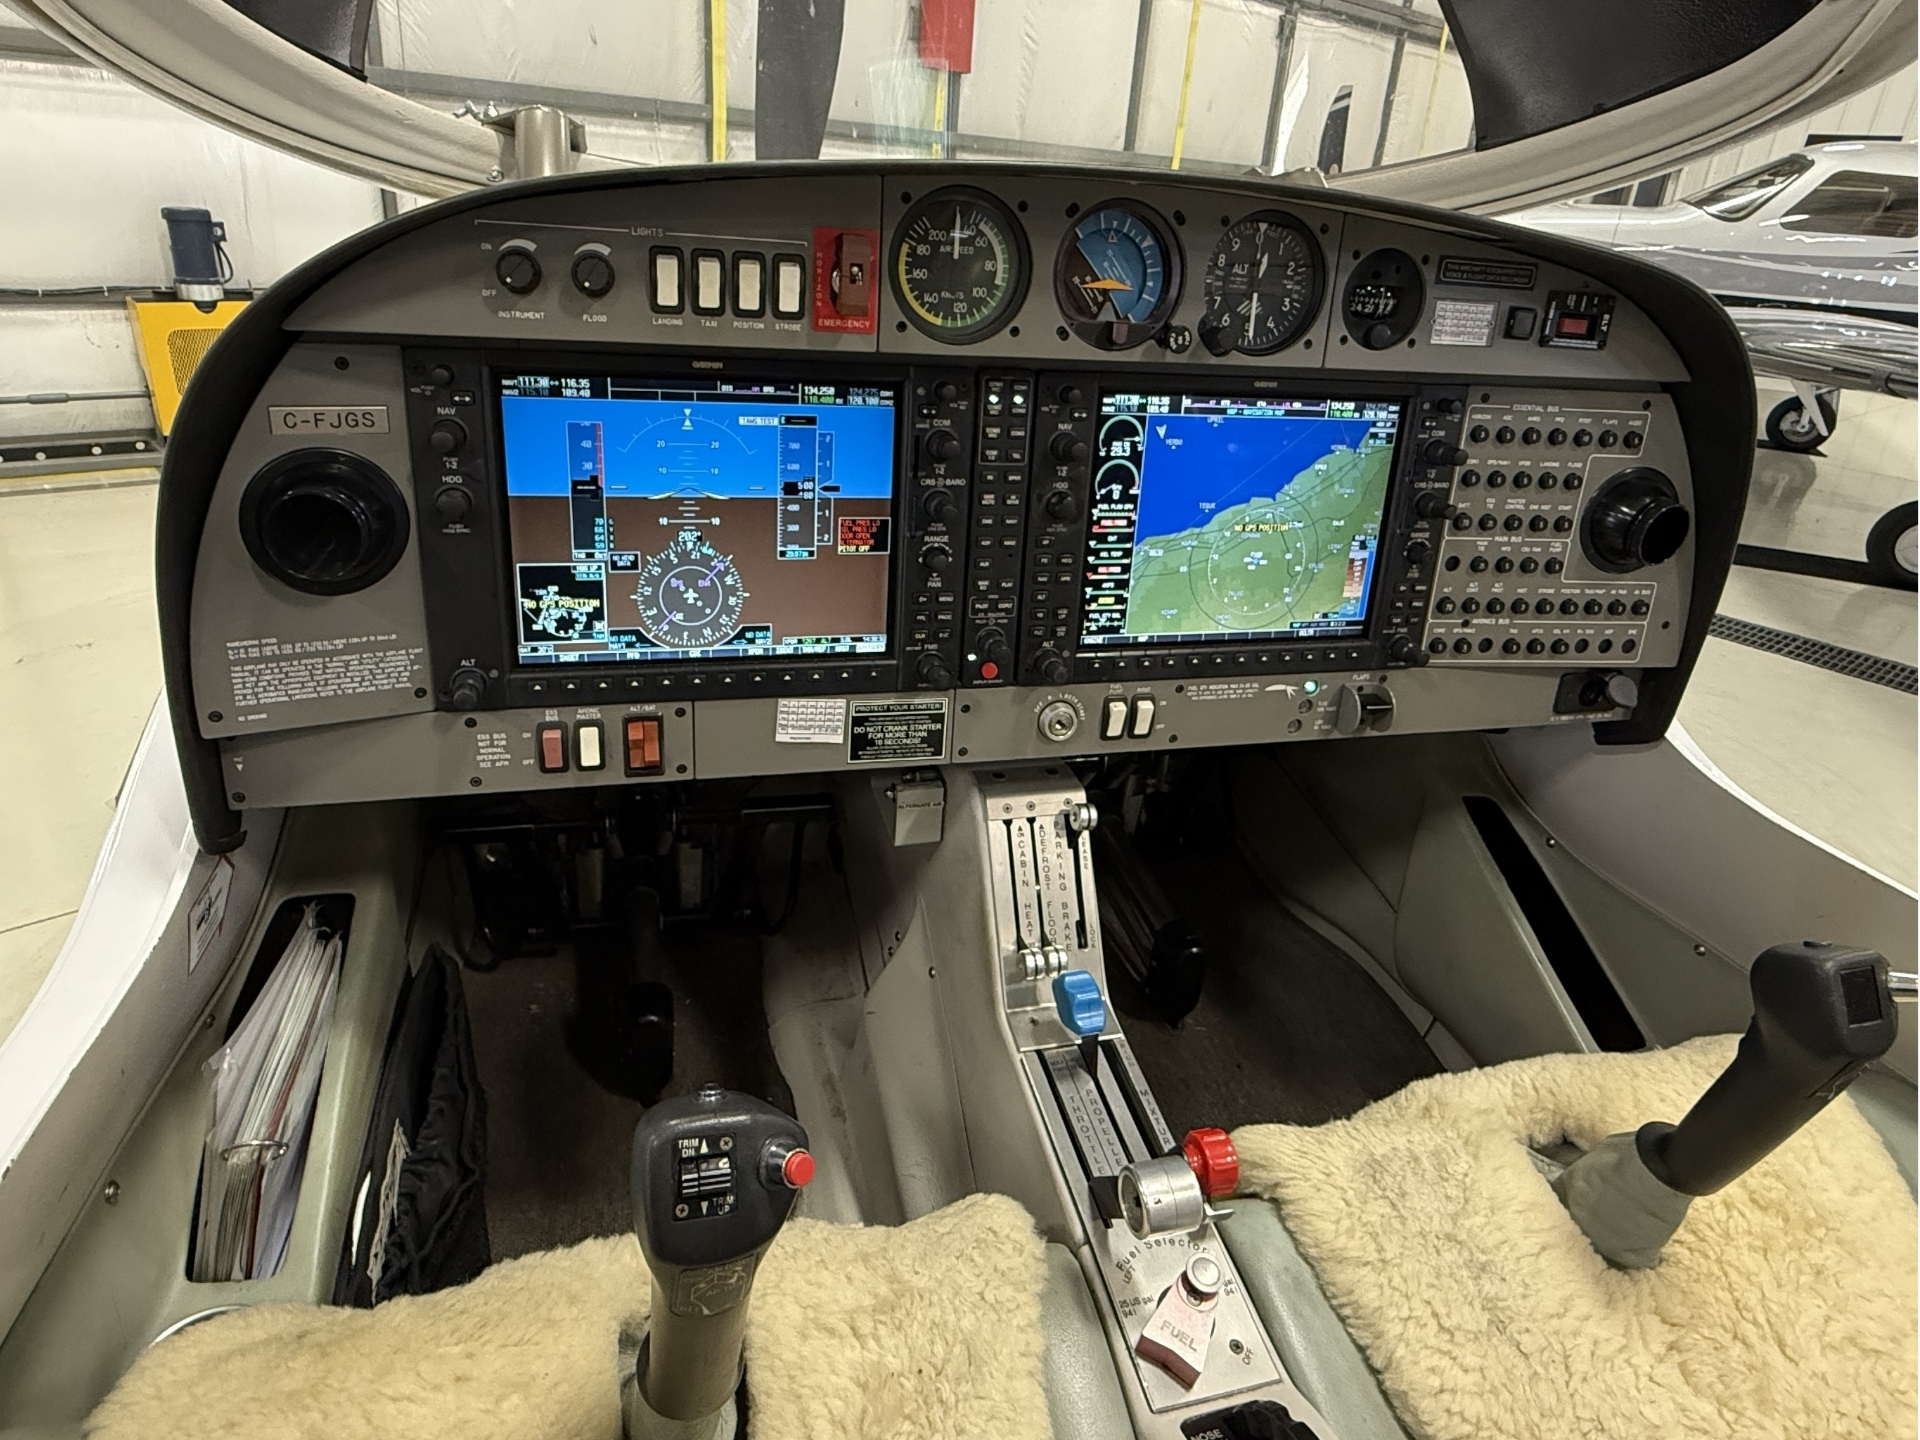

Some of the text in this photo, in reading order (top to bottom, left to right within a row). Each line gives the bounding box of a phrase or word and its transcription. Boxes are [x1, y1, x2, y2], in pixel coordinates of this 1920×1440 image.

[631, 227, 664, 237] LIGHTS
[928, 229, 947, 241] 200
[964, 225, 976, 236] 40
[975, 237, 988, 248] 60
[1256, 232, 1264, 245] 0
[916, 244, 930, 255] 180
[1231, 238, 1241, 251] 9
[1279, 243, 1285, 255] 1
[939, 246, 974, 255] AIREED
[1217, 254, 1226, 266] 8
[984, 260, 996, 271] 80
[1232, 264, 1250, 275] ALT
[1286, 262, 1295, 275] 2
[912, 268, 928, 279] 160
[481, 289, 497, 297] OFF
[972, 287, 987, 298] 100
[924, 294, 939, 304] 140
[1213, 297, 1222, 309] 7
[953, 302, 967, 313] 120
[1281, 298, 1291, 311] 3
[1351, 302, 1364, 311] 24
[498, 311, 545, 320] INSTRUMENT
[582, 314, 607, 323] FLOOD
[1222, 313, 1230, 326] 6
[652, 318, 683, 326] LANDING
[818, 319, 871, 330] EMERGENCY
[1266, 316, 1277, 327] 4
[1601, 313, 1610, 332] ELT
[775, 323, 802, 331] STROBE
[1244, 323, 1252, 335] 5
[518, 377, 549, 387] 111.30
[560, 379, 590, 388] 116.35
[804, 386, 835, 396] 134.250
[437, 406, 456, 415] NAV
[1513, 404, 1544, 412] ESSENTIAL
[283, 412, 376, 429] C-FJGS
[743, 416, 776, 425] TAWS TEST
[933, 420, 951, 428] COM
[1058, 423, 1073, 432] NAV
[656, 439, 666, 448] 20
[825, 434, 831, 444] 2
[580, 440, 592, 449] 40
[710, 440, 720, 449] 20
[788, 441, 800, 450] 700
[1110, 446, 1130, 456] 29.3
[581, 462, 593, 471] 30
[787, 464, 800, 472] 600
[826, 460, 831, 468] 1
[658, 466, 667, 475] 10
[711, 467, 720, 475] 10
[442, 474, 463, 484] HDG
[920, 479, 936, 487] CRS
[1053, 482, 1069, 491] HDG
[788, 503, 800, 512] 400
[658, 517, 668, 526] 10
[711, 516, 721, 525] 10
[786, 524, 800, 533] 300
[823, 533, 830, 543] 2
[924, 535, 949, 543] RANGE
[927, 581, 942, 589] PAN
[525, 599, 600, 609] NO GPS POSITION
[1472, 617, 1496, 625] AVIONICS
[924, 643, 938, 652] FMS
[1042, 640, 1055, 648] ALT
[461, 656, 476, 665] ALT
[910, 723, 942, 731] STARTER
[1081, 834, 1090, 870] LEASE
[1039, 830, 1051, 891] DEFROST
[1018, 840, 1034, 938] CABIN HEAT
[1054, 821, 1073, 952] PARKING BRAKE
[1047, 901, 1057, 945] FLOOR
[1089, 923, 1097, 949] LOCK
[1139, 1088, 1173, 1147] MIXTUR
[1085, 1088, 1123, 1168] PROPELLE
[1068, 1095, 1107, 1175] THROTTLE
[678, 1138, 699, 1148] TRIM
[681, 1148, 695, 1159] DN
[713, 1195, 735, 1206] TRIM
[717, 1205, 730, 1216] UP
[1115, 1236, 1208, 1273] Fuel Selector
[1122, 1265, 1136, 1284] LEFT
[1118, 1298, 1130, 1309] 25
[1130, 1295, 1142, 1307] US
[1160, 1319, 1198, 1352] FUEL
[1241, 1346, 1255, 1365] OFF
[1190, 1428, 1224, 1440] NOSE
